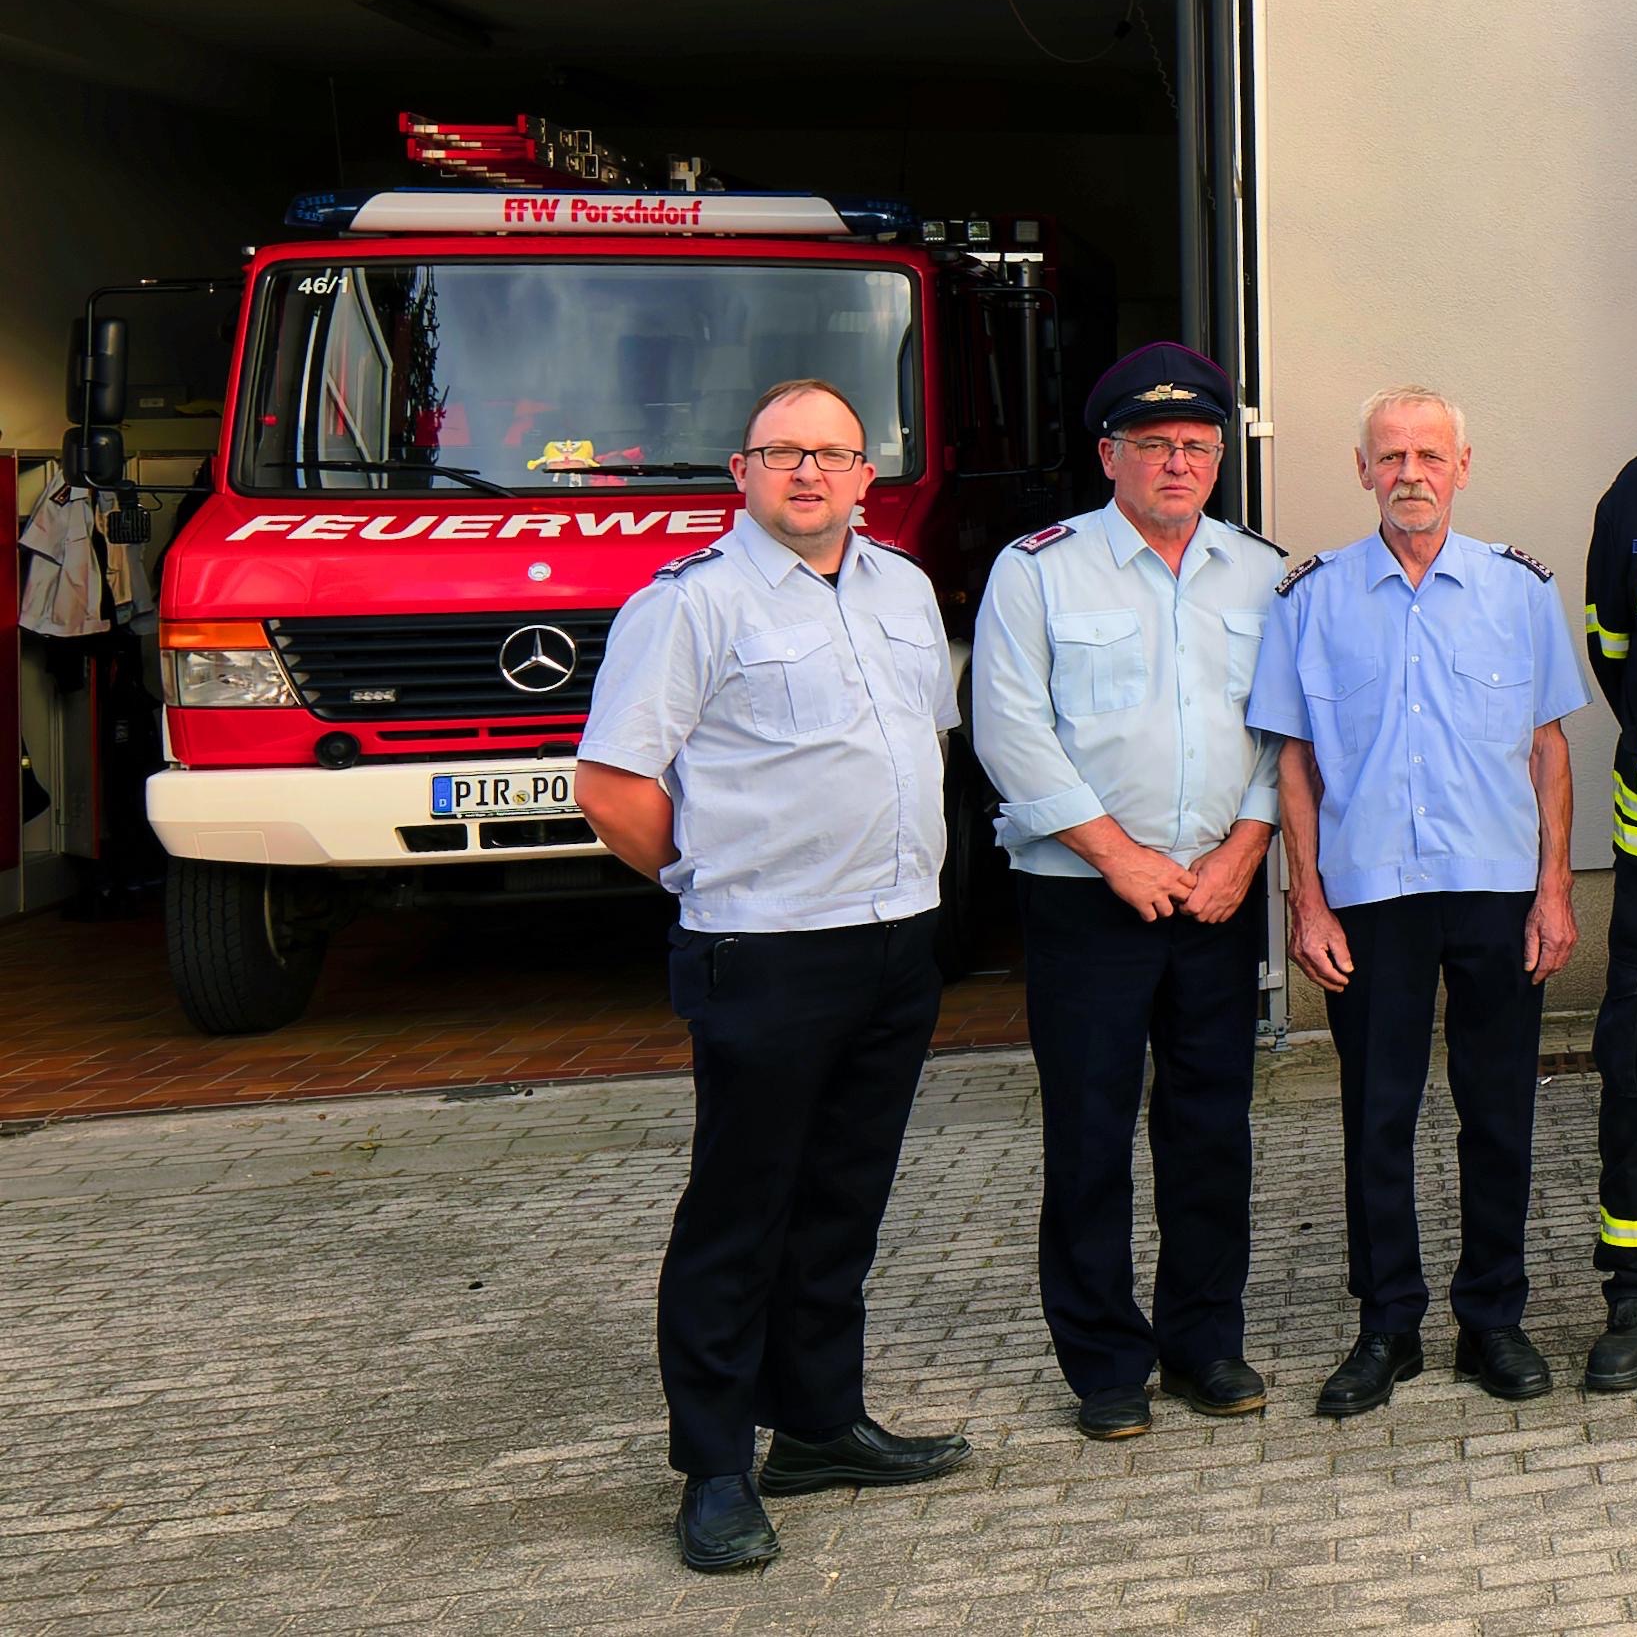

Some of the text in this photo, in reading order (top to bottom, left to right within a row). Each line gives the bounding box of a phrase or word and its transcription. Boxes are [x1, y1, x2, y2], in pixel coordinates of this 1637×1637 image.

[504, 198, 703, 226] FFW Porschdorf
[297, 275, 349, 295] 46/1
[454, 775, 569, 808] PIR PO
